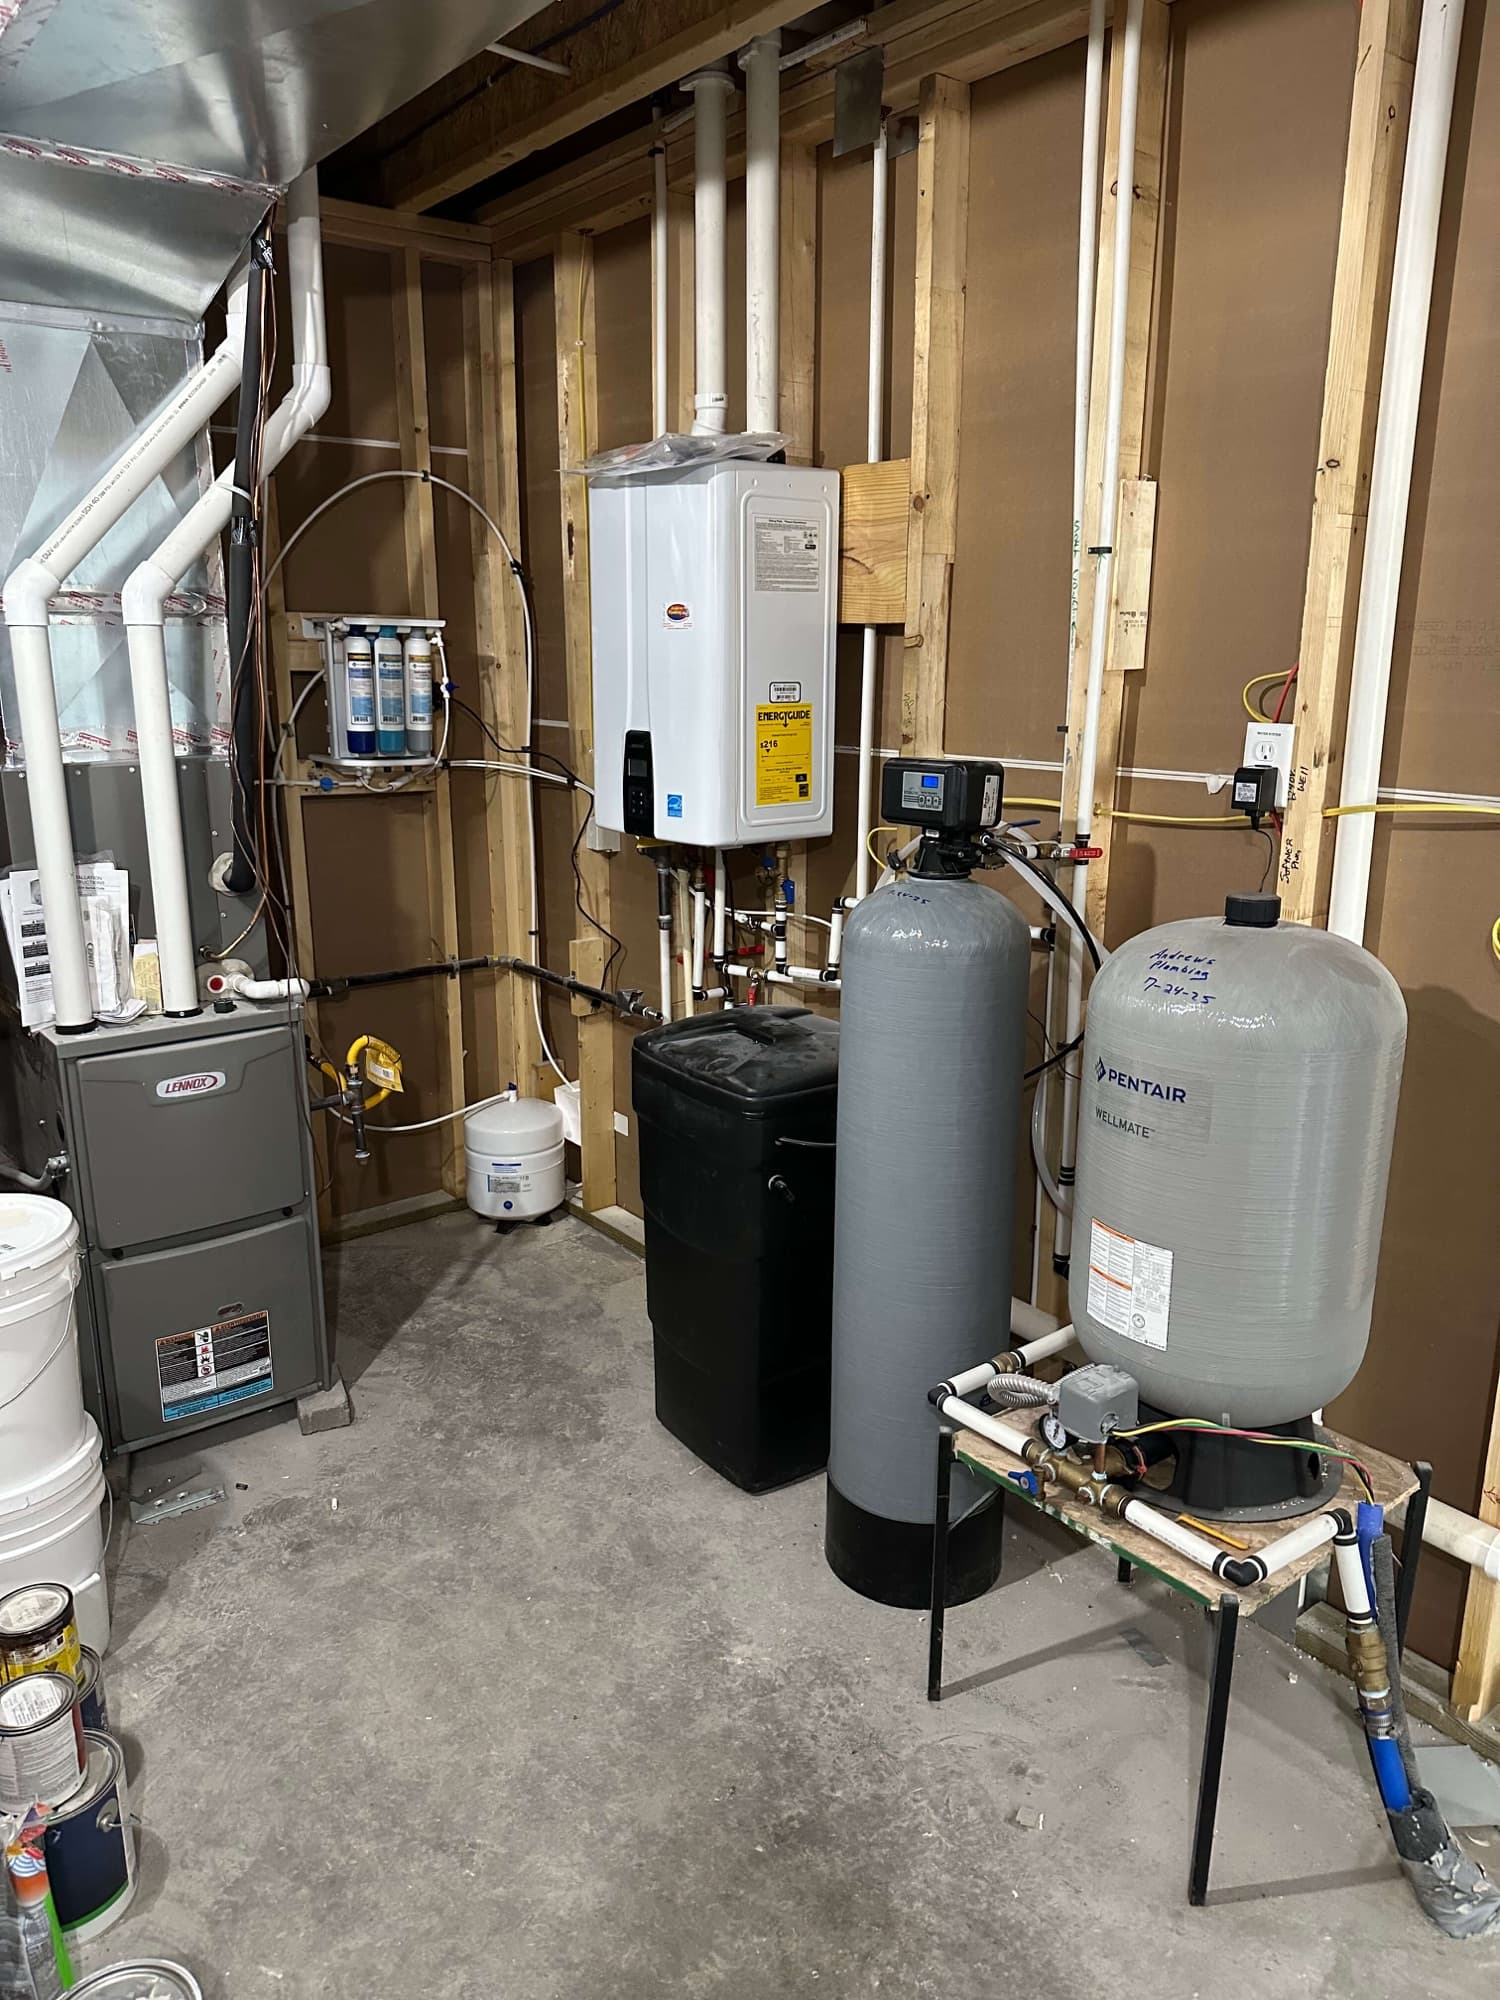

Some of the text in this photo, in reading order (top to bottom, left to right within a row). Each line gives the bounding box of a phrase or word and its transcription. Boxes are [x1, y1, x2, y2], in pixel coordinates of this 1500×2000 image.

[757, 710, 811, 722] ENERGYGUIDE
[759, 740, 778, 749] $216
[1149, 948, 1217, 965] Andrews
[1143, 976, 1217, 1004] 7-24-25
[165, 1077, 208, 1094] LENNOX
[1108, 1068, 1187, 1104] PENTAIR
